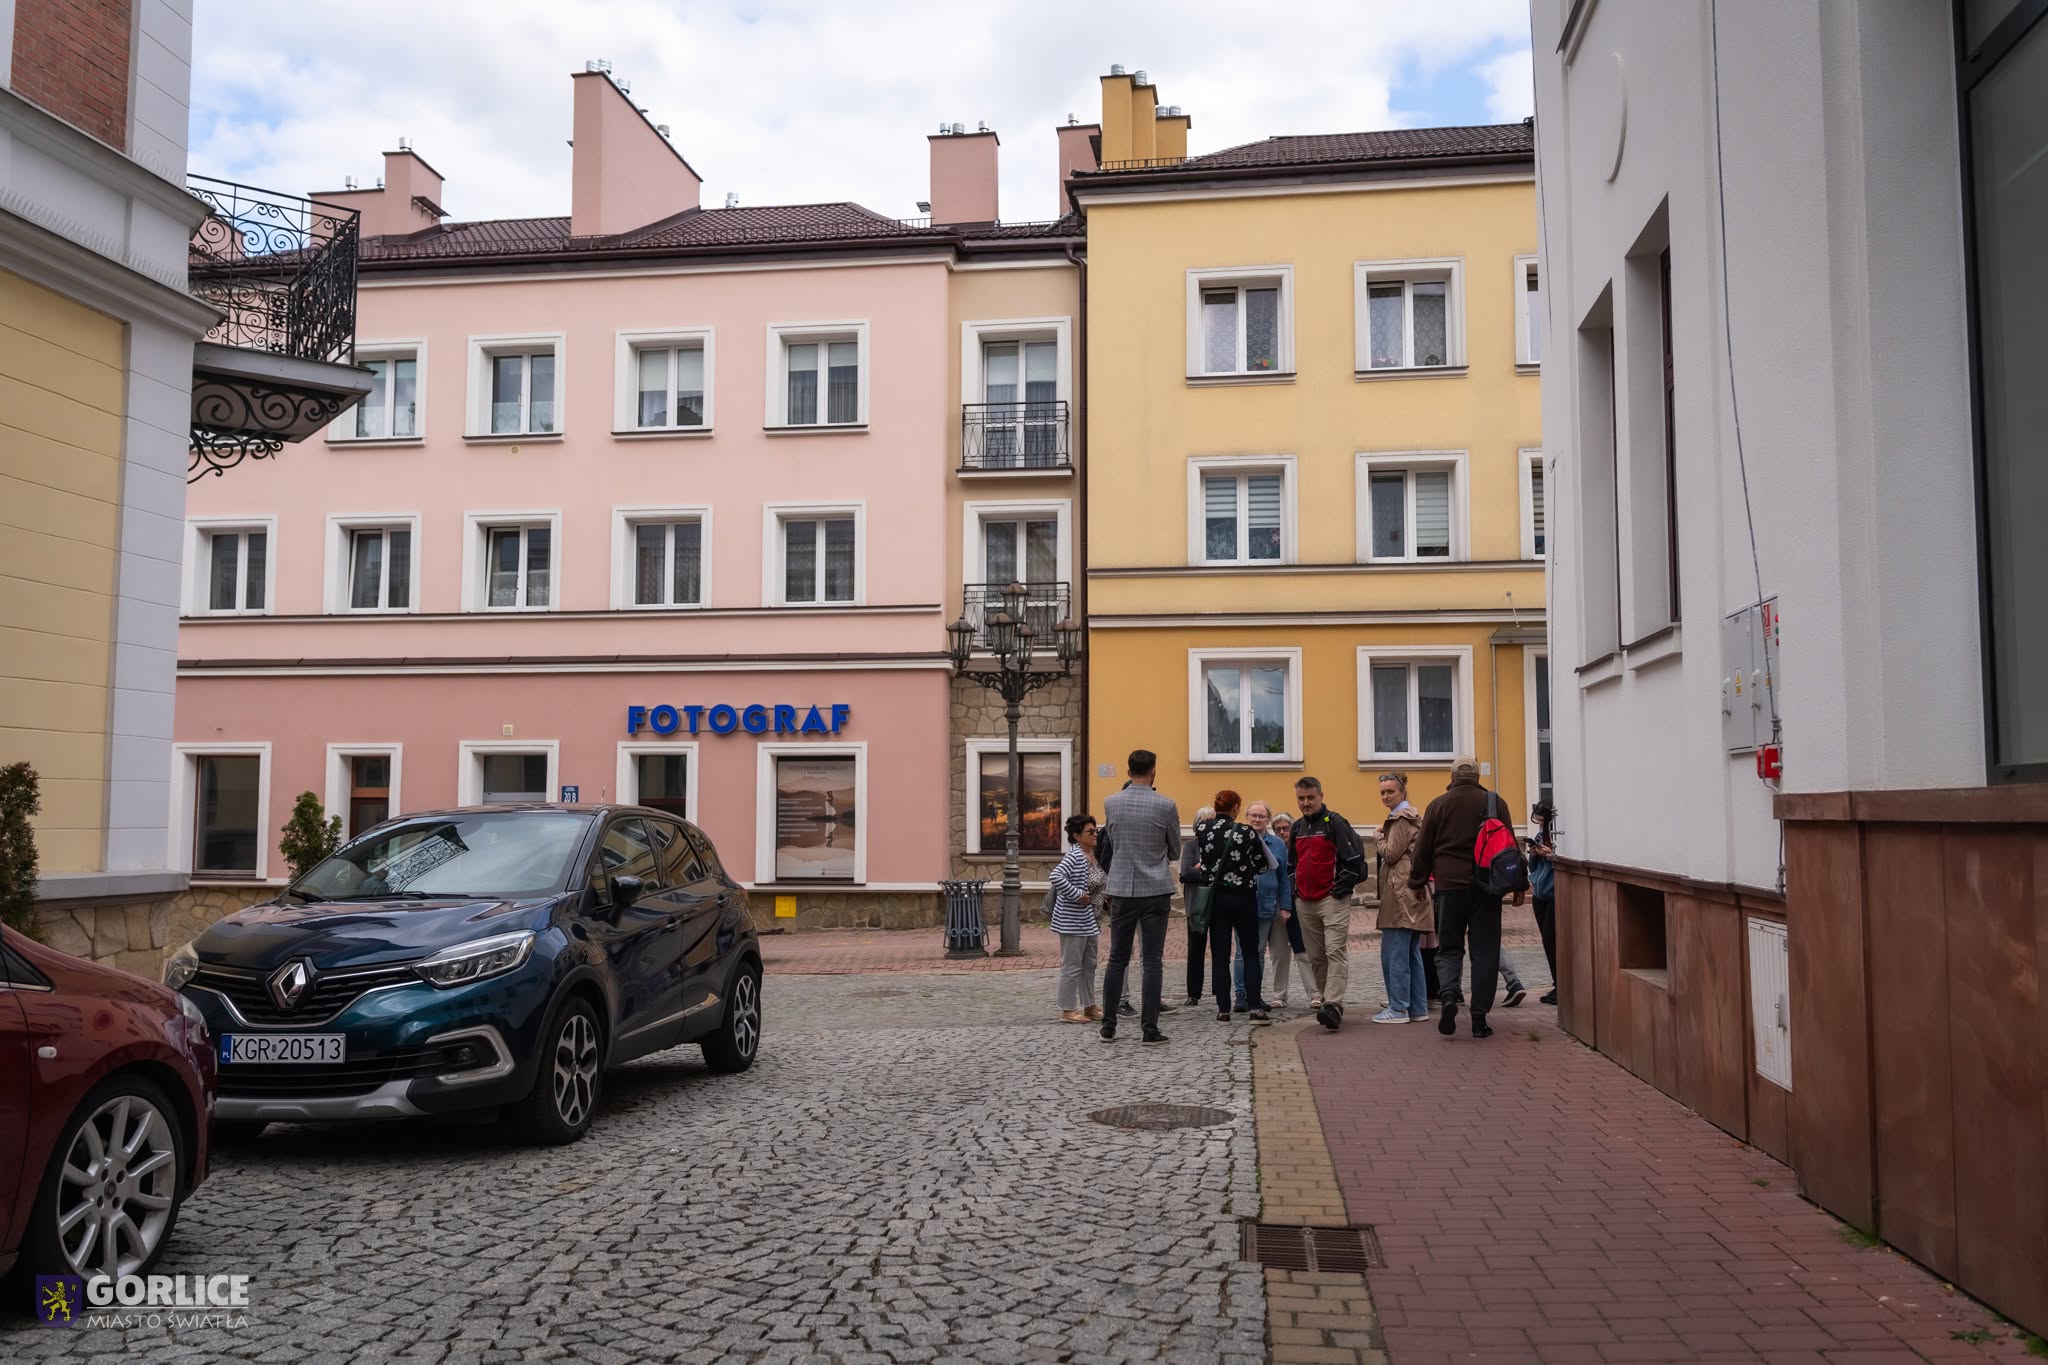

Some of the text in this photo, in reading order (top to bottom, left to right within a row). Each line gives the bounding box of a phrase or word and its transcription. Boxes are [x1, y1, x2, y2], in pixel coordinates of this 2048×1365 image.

[628, 704, 850, 734] FOTOGRAF
[232, 1038, 341, 1060] KGR 20513
